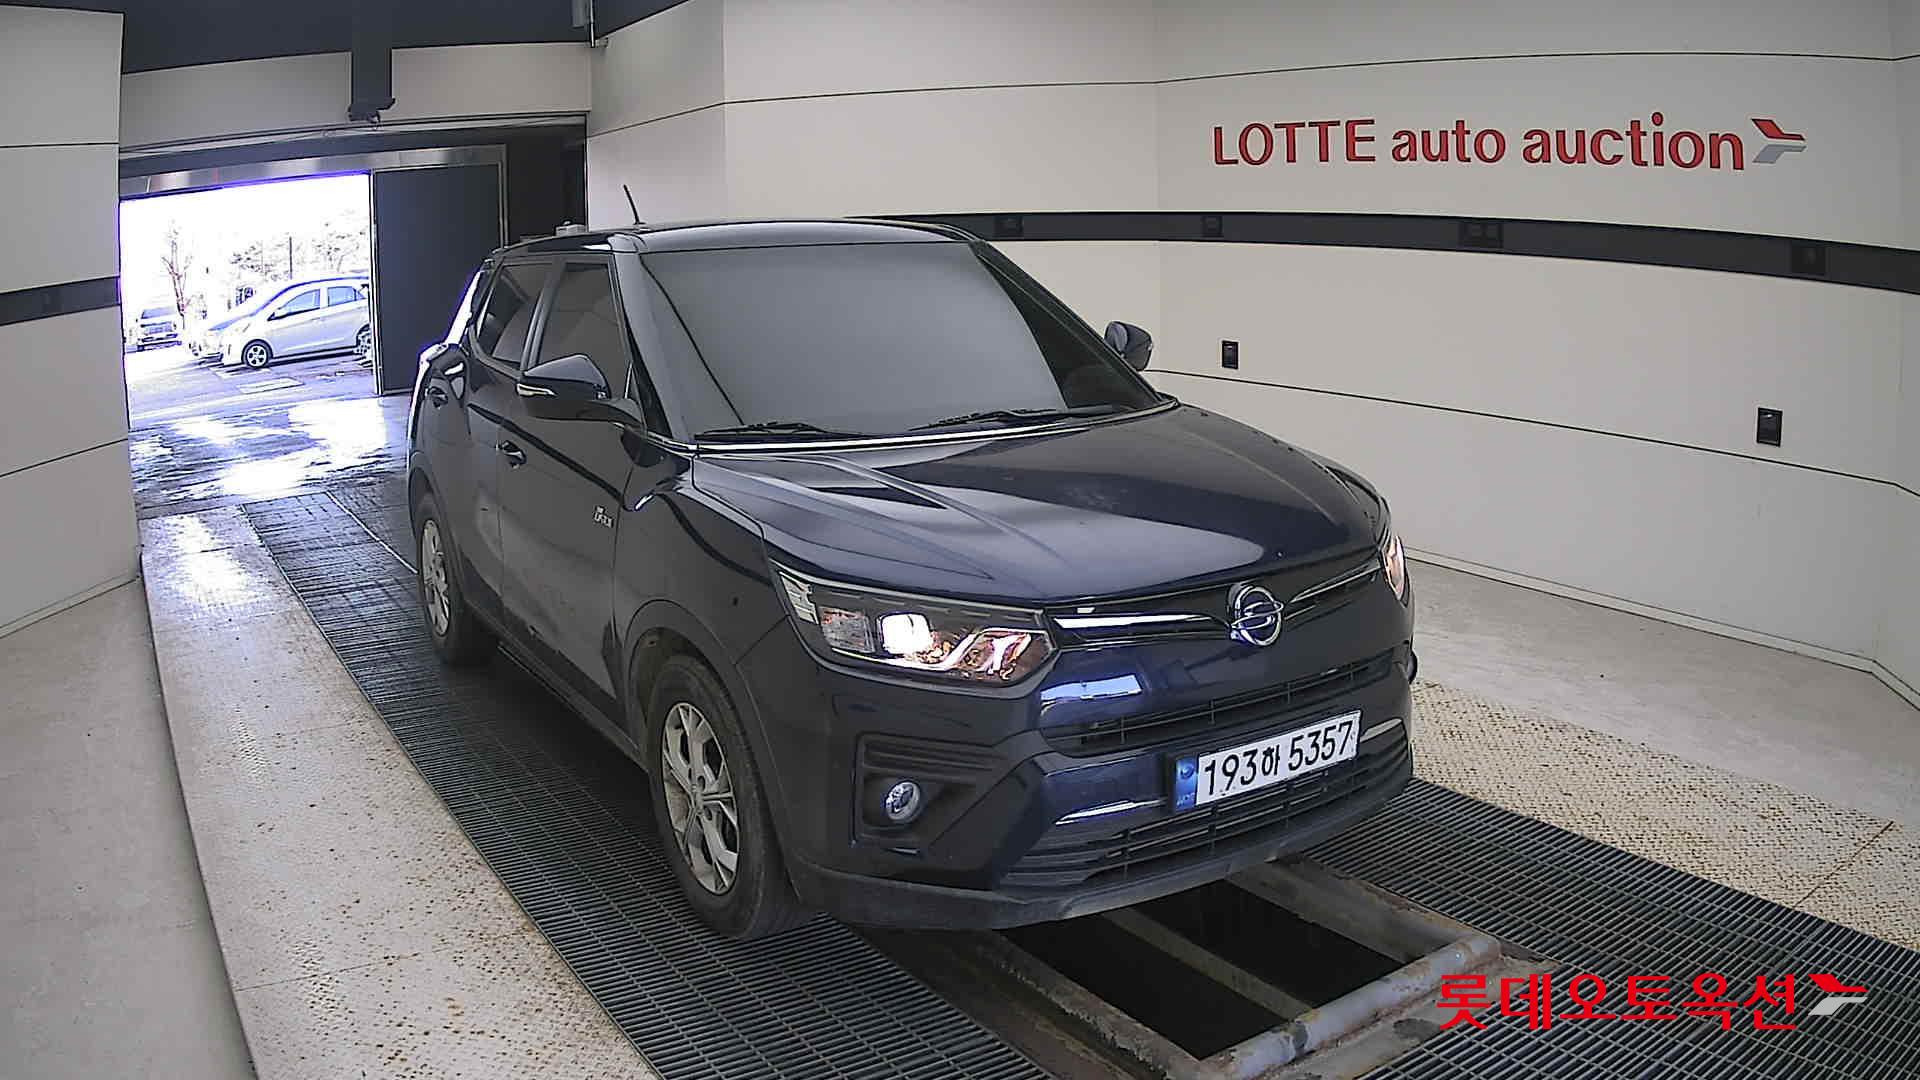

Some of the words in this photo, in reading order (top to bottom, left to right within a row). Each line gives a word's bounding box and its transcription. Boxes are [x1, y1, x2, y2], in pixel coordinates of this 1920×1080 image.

[1214, 119, 1376, 166] LOTTE
[1391, 119, 1507, 163] auto
[1521, 112, 1745, 171] auction
[1204, 745, 1281, 796] 193하
[1288, 720, 1354, 771] 5357
